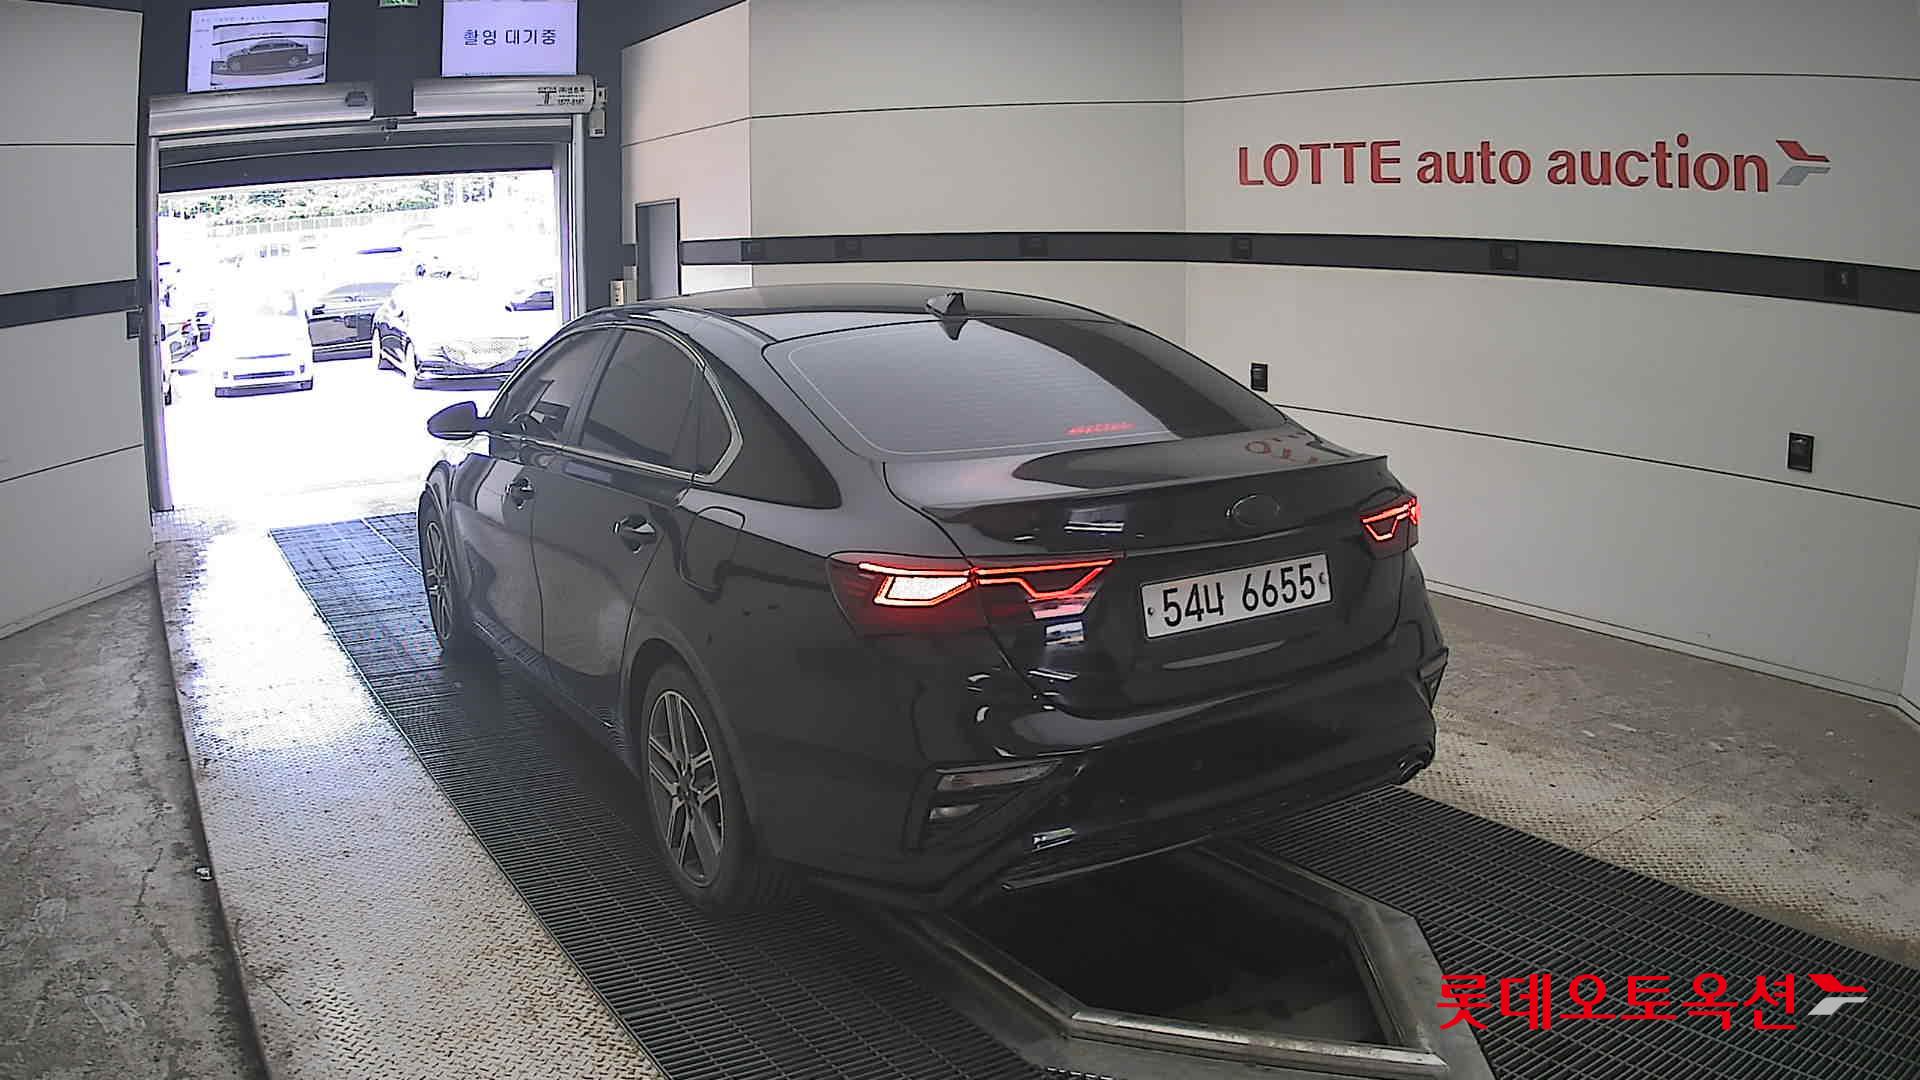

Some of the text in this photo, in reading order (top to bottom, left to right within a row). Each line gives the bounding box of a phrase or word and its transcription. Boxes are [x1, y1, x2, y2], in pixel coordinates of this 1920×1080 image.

[463, 28, 556, 46] 촬영 대기중
[1238, 133, 1769, 193] LOTTE auto auction
[1162, 562, 1316, 628] 54나 6655
